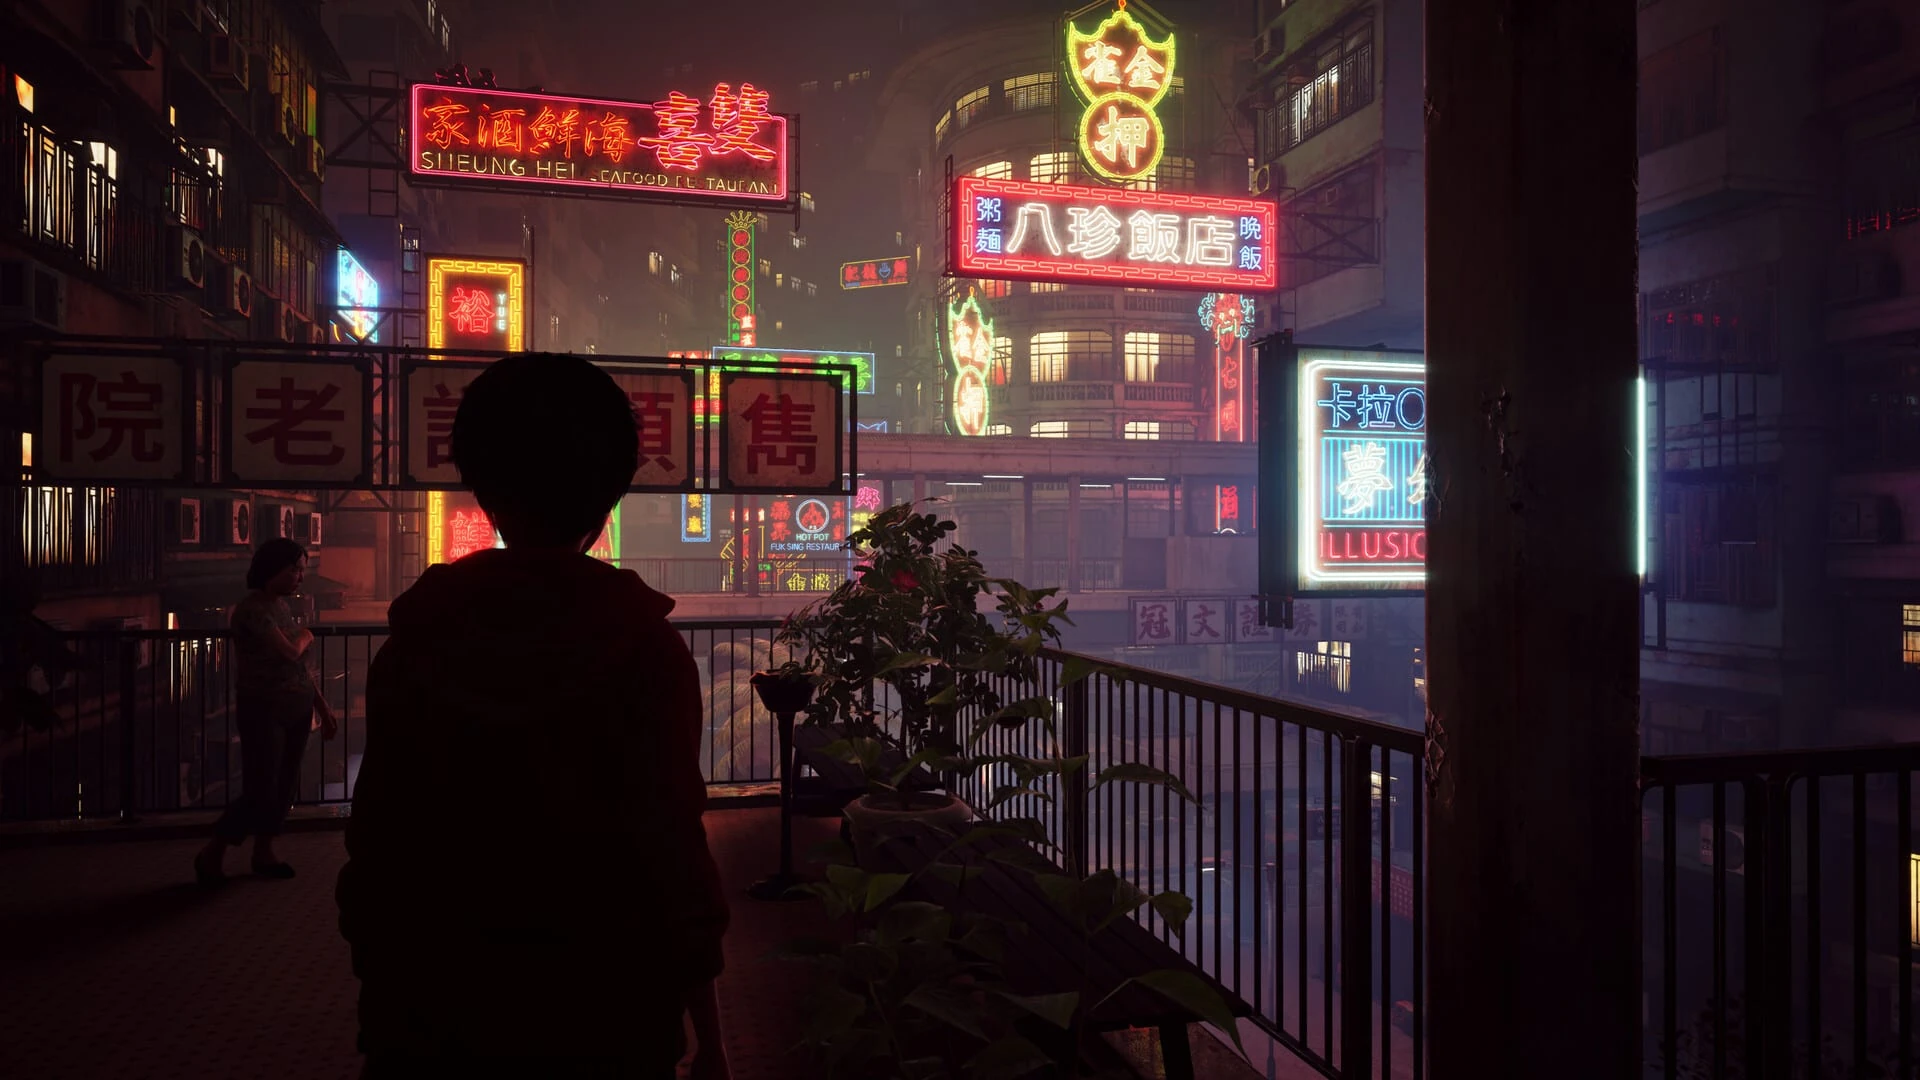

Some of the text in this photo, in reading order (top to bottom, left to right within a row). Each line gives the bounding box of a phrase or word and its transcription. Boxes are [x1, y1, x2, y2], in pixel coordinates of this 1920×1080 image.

[1095, 106, 1150, 168] 押
[1005, 202, 1235, 266] 八珍飯店
[1238, 216, 1262, 271] 晚飯
[449, 286, 495, 334] 裕
[497, 292, 506, 331] YUE
[770, 542, 785, 551] FUK
[786, 542, 804, 551] SING
[796, 533, 830, 541] HOT POT
